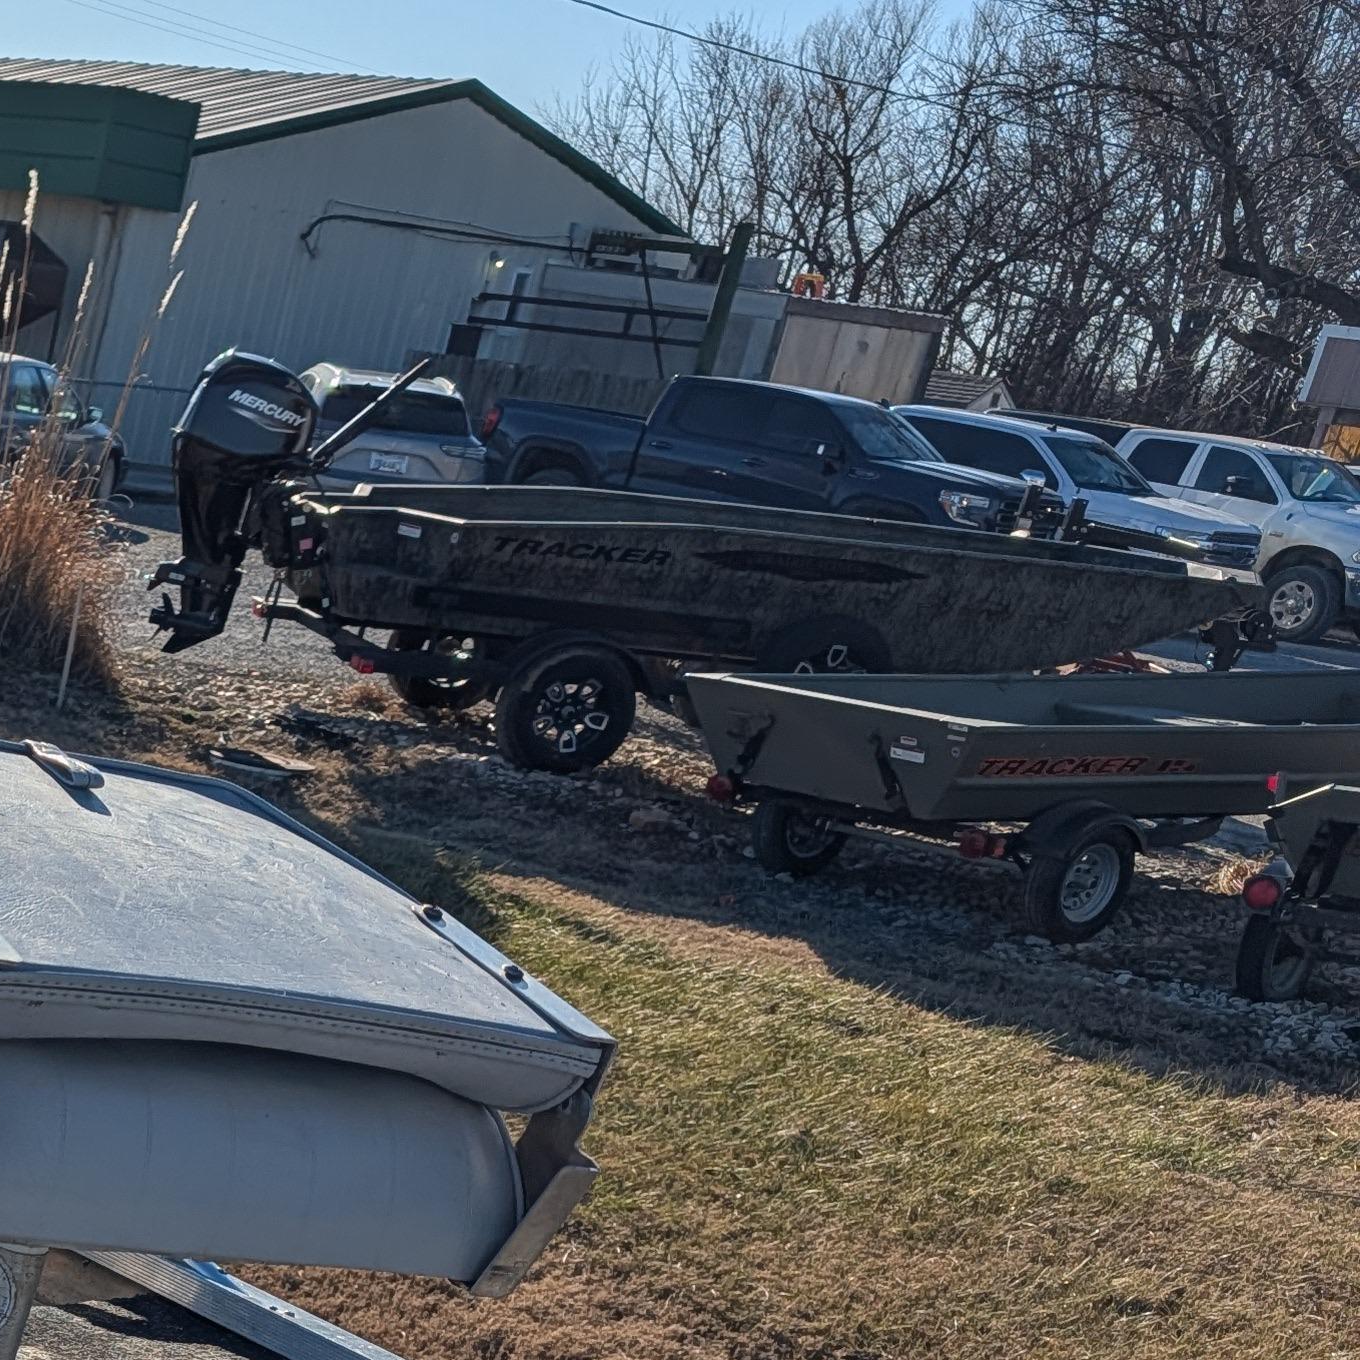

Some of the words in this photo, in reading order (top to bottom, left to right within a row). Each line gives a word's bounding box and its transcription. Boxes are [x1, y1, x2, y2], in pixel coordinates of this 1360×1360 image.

[228, 388, 307, 427] MERCURY
[494, 536, 673, 566] TRACKER
[978, 756, 1151, 776] TRACKER
